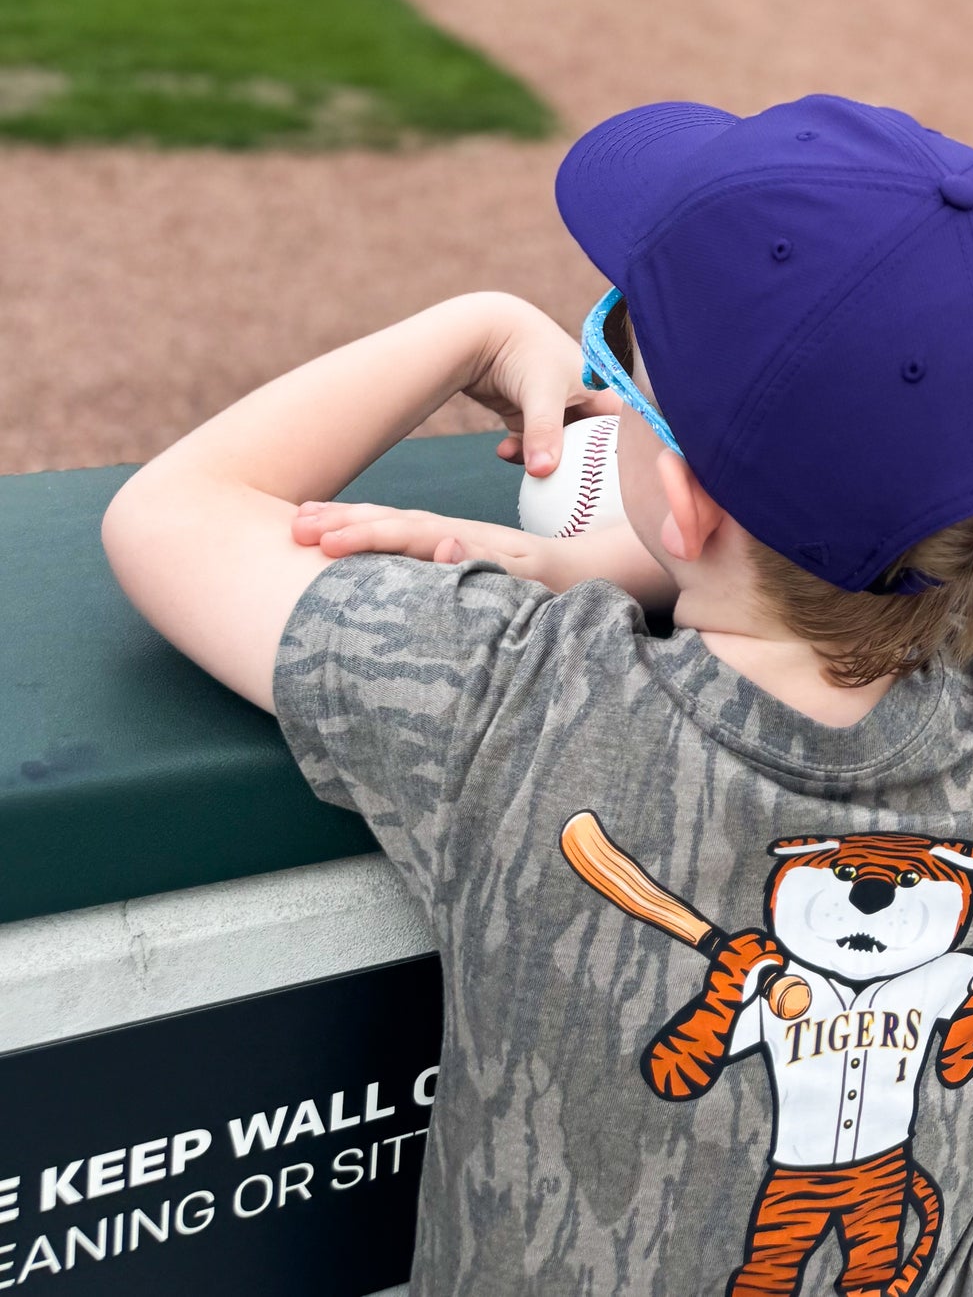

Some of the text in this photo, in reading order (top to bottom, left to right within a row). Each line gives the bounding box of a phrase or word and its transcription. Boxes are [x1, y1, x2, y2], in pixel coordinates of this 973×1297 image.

[785, 1008, 922, 1065] TIGERS
[895, 1056, 907, 1083] 1
[40, 1128, 212, 1212] KEEP
[228, 1081, 396, 1159] WALL
[232, 1162, 315, 1219] OR
